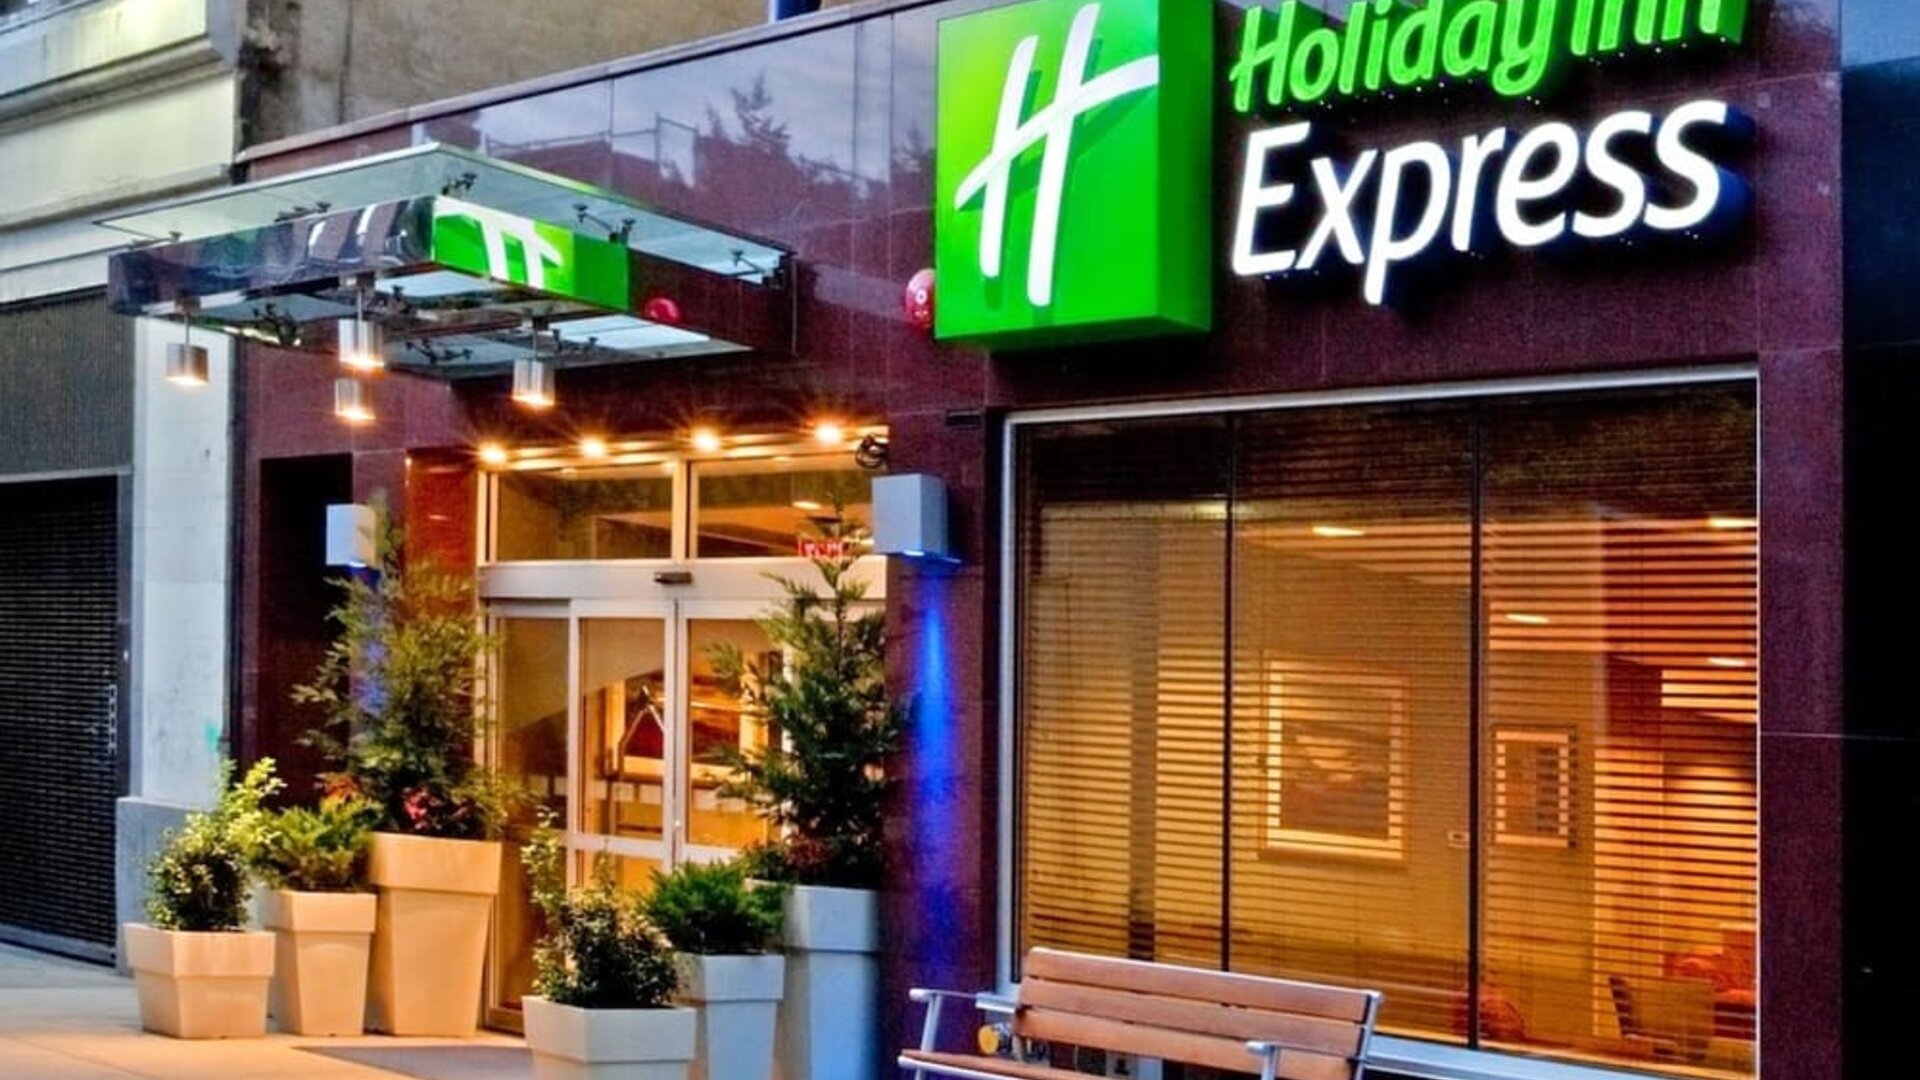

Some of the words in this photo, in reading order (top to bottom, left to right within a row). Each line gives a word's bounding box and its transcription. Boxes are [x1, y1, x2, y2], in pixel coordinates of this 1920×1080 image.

[954, 3, 1159, 307] H
[1229, 0, 1557, 112] Holiday
[1230, 100, 1728, 306] Express
